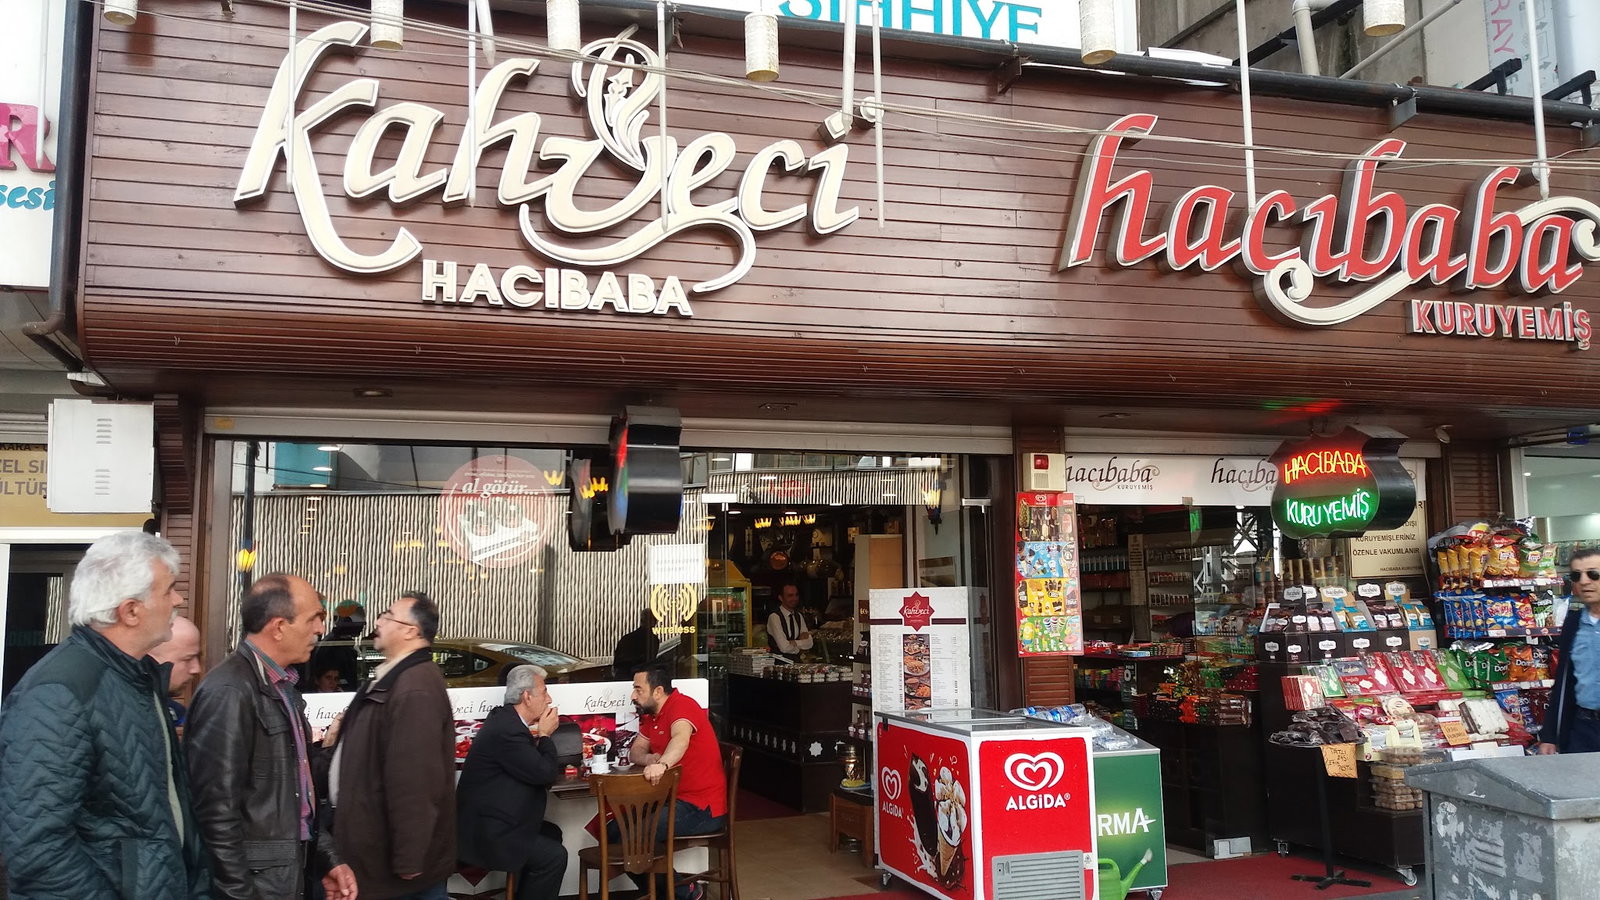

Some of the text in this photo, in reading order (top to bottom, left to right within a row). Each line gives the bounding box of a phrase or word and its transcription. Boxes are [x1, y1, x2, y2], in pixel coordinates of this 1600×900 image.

[421, 258, 694, 318] HACIBABA
[1409, 298, 1591, 351] KURUYEMİŞ
[0, 459, 48, 474] EL SI
[1284, 450, 1367, 485] HACIBABA
[0, 477, 48, 496] LTÜR
[1286, 487, 1370, 528] KURUYEMİŞ
